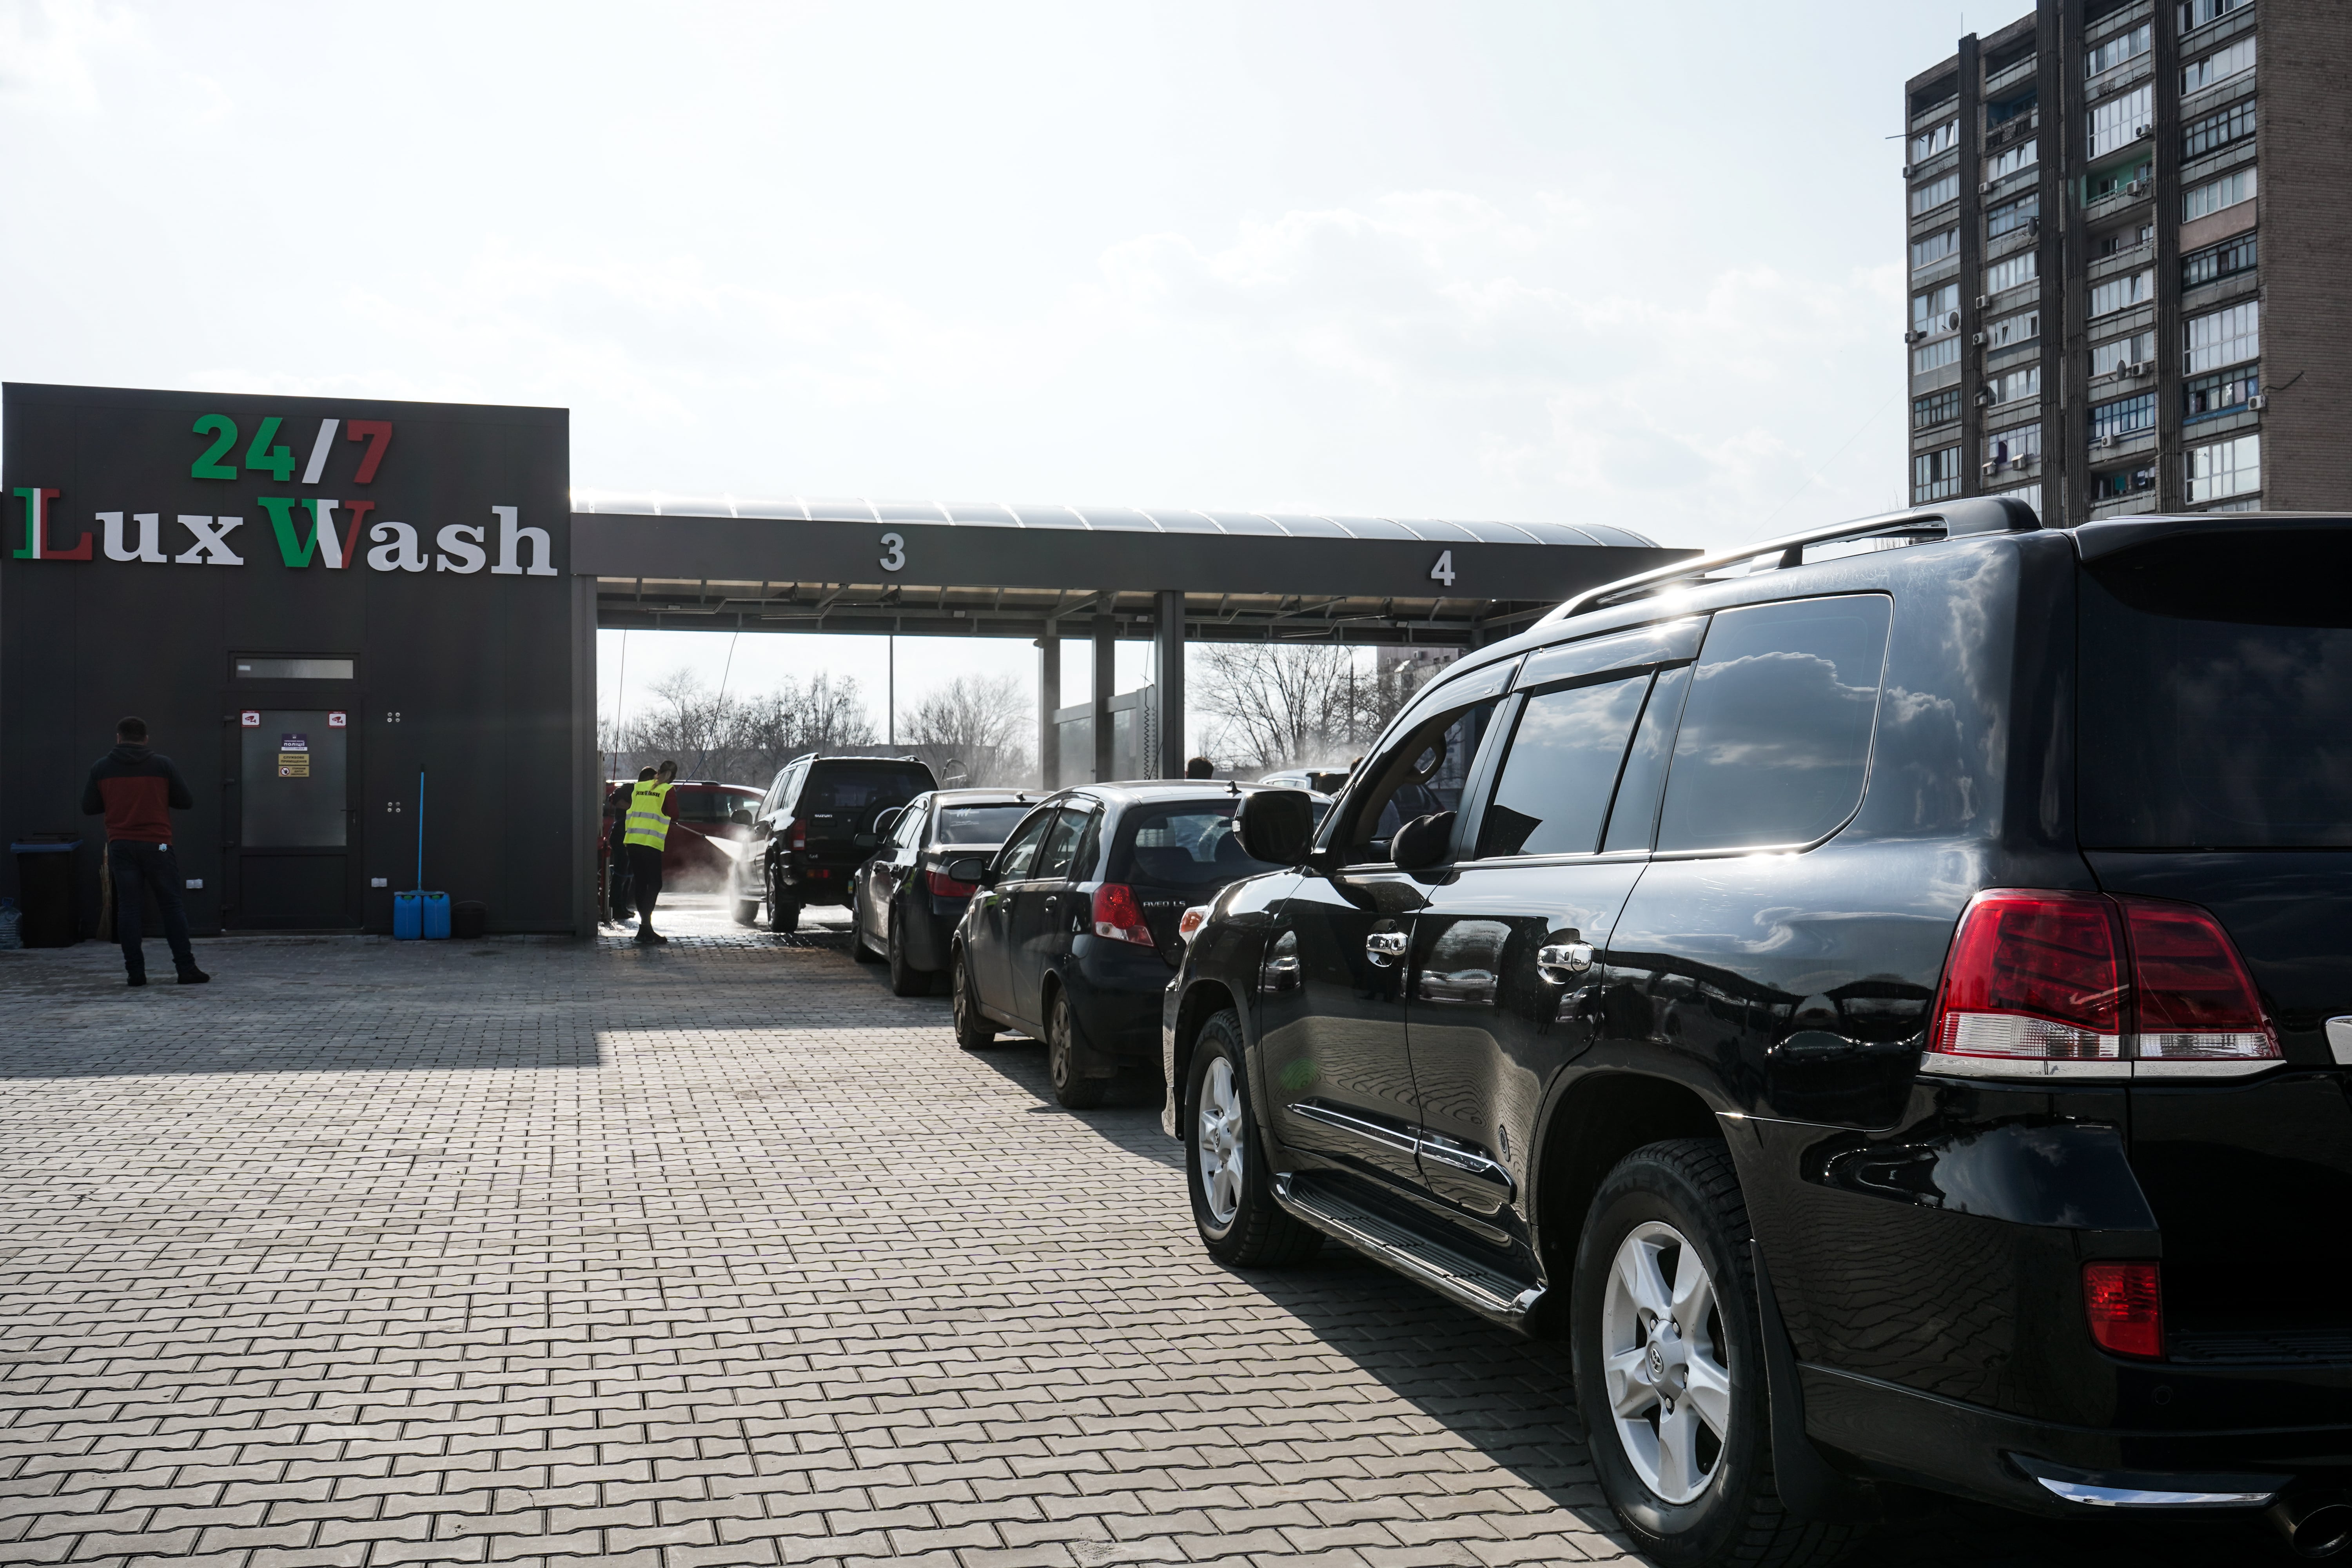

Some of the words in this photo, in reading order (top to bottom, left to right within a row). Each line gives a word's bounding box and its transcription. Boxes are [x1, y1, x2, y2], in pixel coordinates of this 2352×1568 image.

[191, 414, 392, 484] 24/7
[13, 487, 244, 566] Lux
[257, 496, 558, 576] Wash
[879, 532, 905, 571] 3
[1431, 550, 1455, 586] 4
